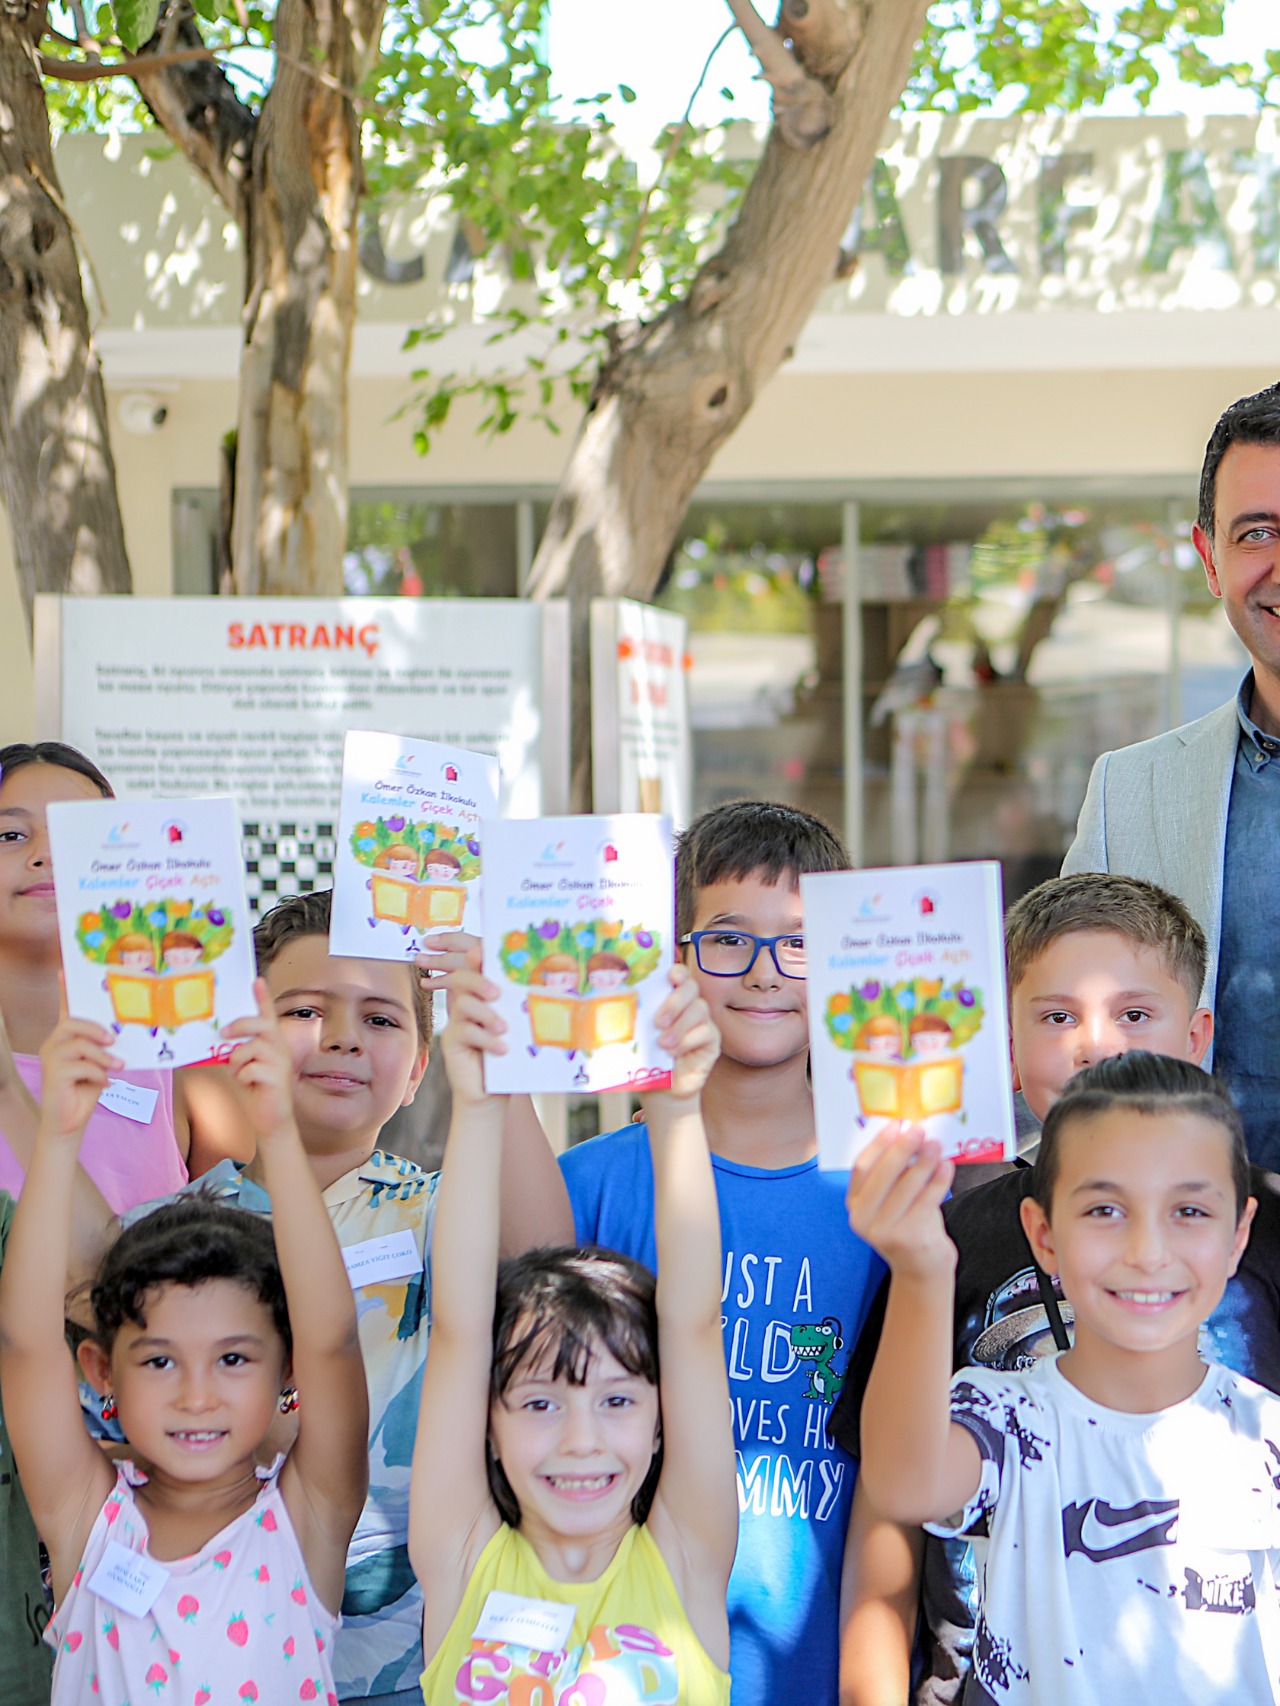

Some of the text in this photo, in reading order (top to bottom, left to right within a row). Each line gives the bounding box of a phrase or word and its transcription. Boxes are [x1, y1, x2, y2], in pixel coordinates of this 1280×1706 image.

[227, 622, 379, 658] SATRANÇ
[361, 792, 416, 808] Kalemler
[421, 800, 453, 816] Çiçek
[374, 780, 477, 808] Ömer Özkan İlkokulu
[793, 1257, 813, 1312] A
